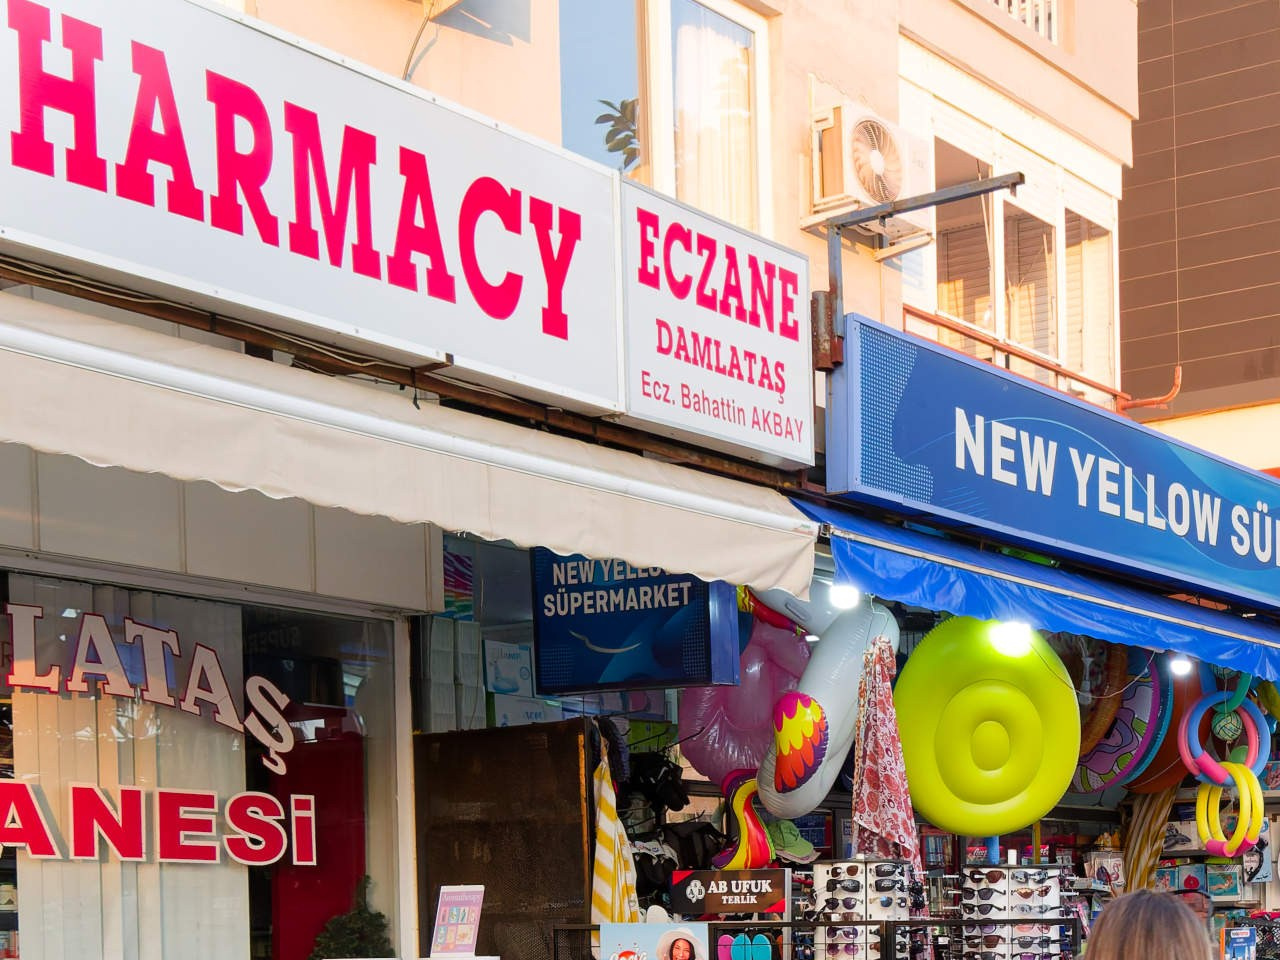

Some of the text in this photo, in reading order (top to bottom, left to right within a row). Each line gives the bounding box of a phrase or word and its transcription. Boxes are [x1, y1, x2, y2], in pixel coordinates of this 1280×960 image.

[8, 0, 582, 341] HARMACY
[636, 207, 800, 343] ECZANE
[655, 317, 787, 404] DAMLATAŞ
[641, 370, 806, 444] Ecz. Bahattin AKBAY
[953, 405, 1058, 498] NEW
[1069, 447, 1222, 548] YELLOW
[543, 582, 697, 617] SÜPERMARKET
[552, 560, 595, 586] NEW
[6, 603, 295, 776] LATAŞ
[707, 879, 773, 894] AB UFUK
[721, 893, 758, 904] TERLİK
